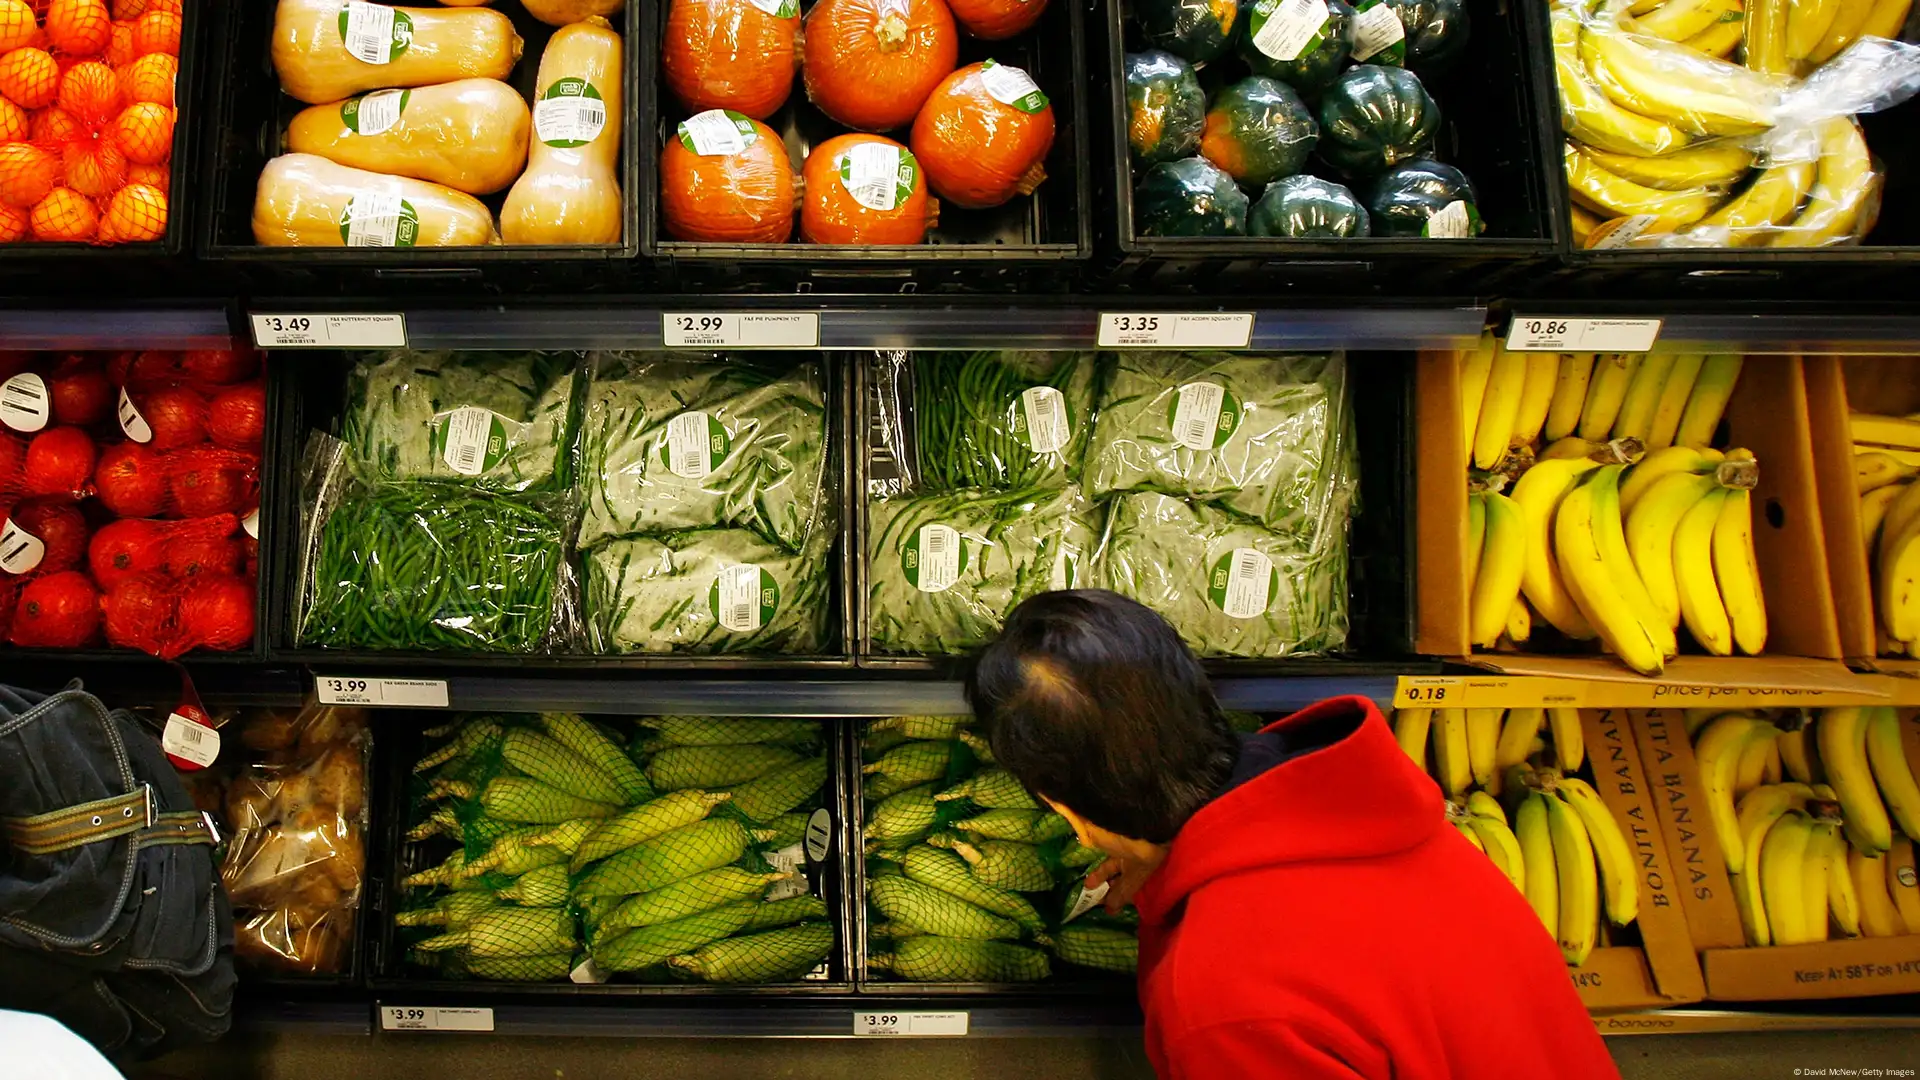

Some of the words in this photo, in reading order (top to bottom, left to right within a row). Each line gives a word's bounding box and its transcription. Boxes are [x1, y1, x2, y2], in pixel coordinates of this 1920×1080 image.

[265, 317, 310, 331] $3.49
[677, 317, 723, 331] $2.99
[1114, 317, 1158, 331] $3.35
[1525, 321, 1568, 335] $0.86
[328, 680, 367, 692] $3.99
[1652, 684, 1704, 699] price
[1404, 688, 1446, 700] $0.18
[1661, 772, 1714, 901] BANANAS
[1627, 803, 1670, 908] BONITA
[391, 1009, 424, 1020] $3.99
[864, 1015, 898, 1026] $3.99
[1608, 1018, 1674, 1028] banana
